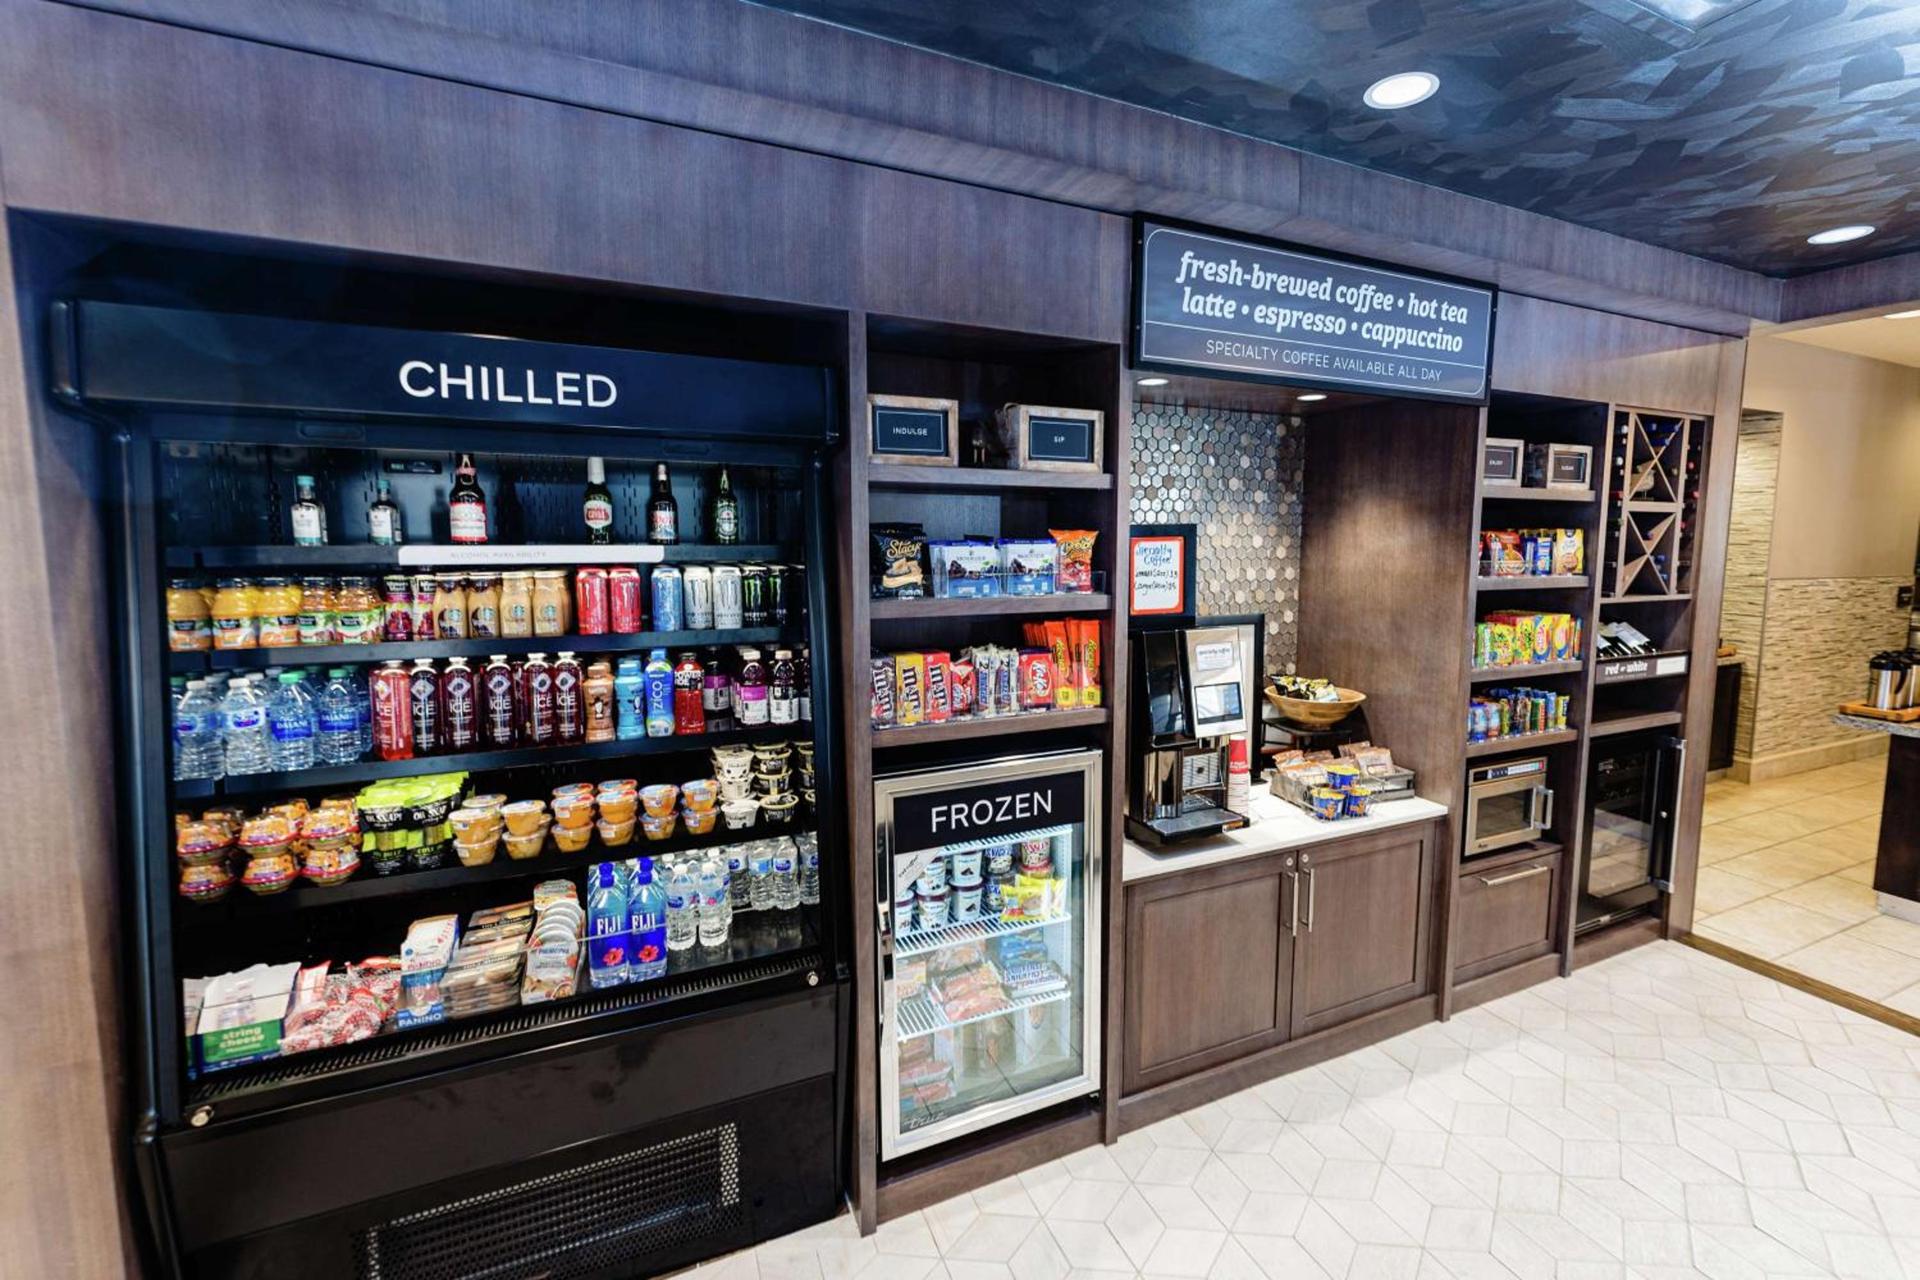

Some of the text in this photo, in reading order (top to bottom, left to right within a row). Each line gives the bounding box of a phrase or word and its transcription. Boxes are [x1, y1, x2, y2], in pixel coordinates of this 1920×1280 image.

[1175, 251, 1468, 325] fresh-brewed coffee hot tea
[1182, 287, 1463, 353] latte espresso cappuccino
[1206, 339, 1442, 383] SPECIALTY COFFEE AVAILABLE ALL DAY
[399, 360, 617, 407] CHILLED
[892, 427, 928, 436] INDULGE
[1605, 661, 1648, 676] red white
[489, 697, 511, 711] ICE
[556, 692, 576, 706] ICE
[652, 681, 664, 711] ZICO
[413, 701, 436, 716] ICE
[449, 700, 472, 714] ICE
[931, 790, 1052, 832] FROZEN
[596, 915, 621, 936] FIJI
[631, 913, 656, 934] FIJI
[399, 1012, 442, 1028] PANINO
[219, 1033, 265, 1049] cheese
[222, 1026, 262, 1041] string
